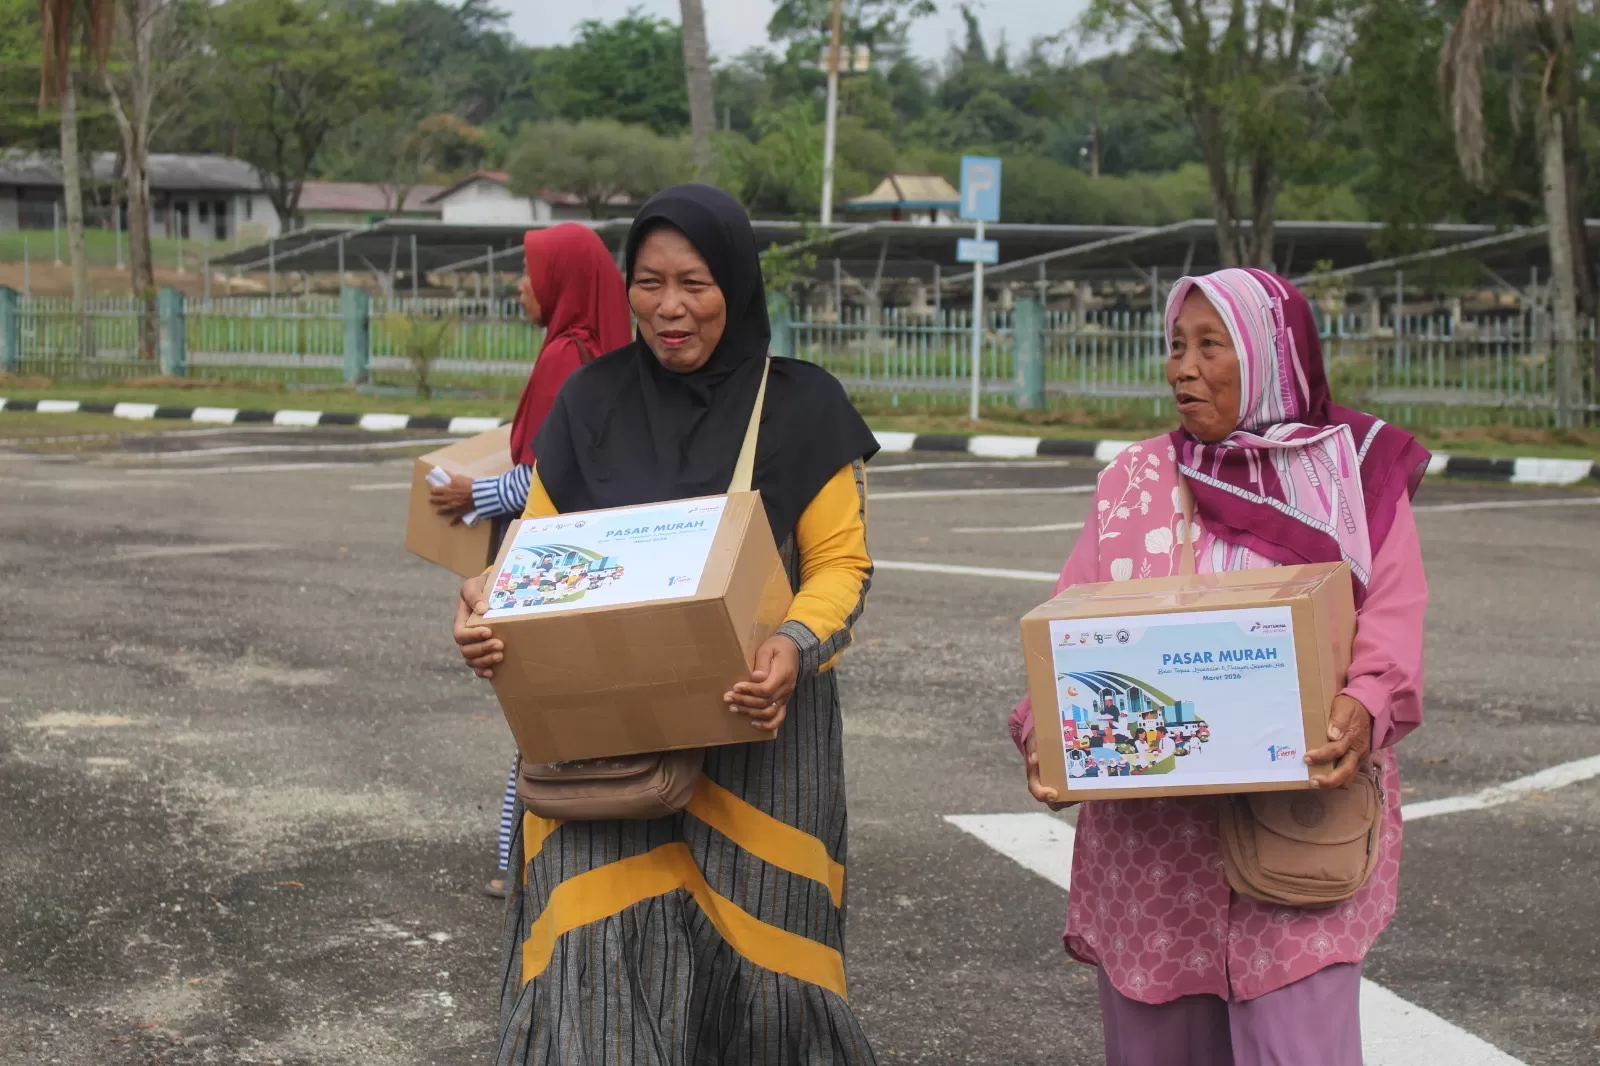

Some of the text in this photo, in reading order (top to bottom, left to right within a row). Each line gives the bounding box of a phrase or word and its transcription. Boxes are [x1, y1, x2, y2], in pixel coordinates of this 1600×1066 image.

[967, 163, 993, 212] P
[606, 527, 649, 538] PASAR
[653, 520, 704, 533] MURAH
[1162, 647, 1278, 665] PASAR MURAH
